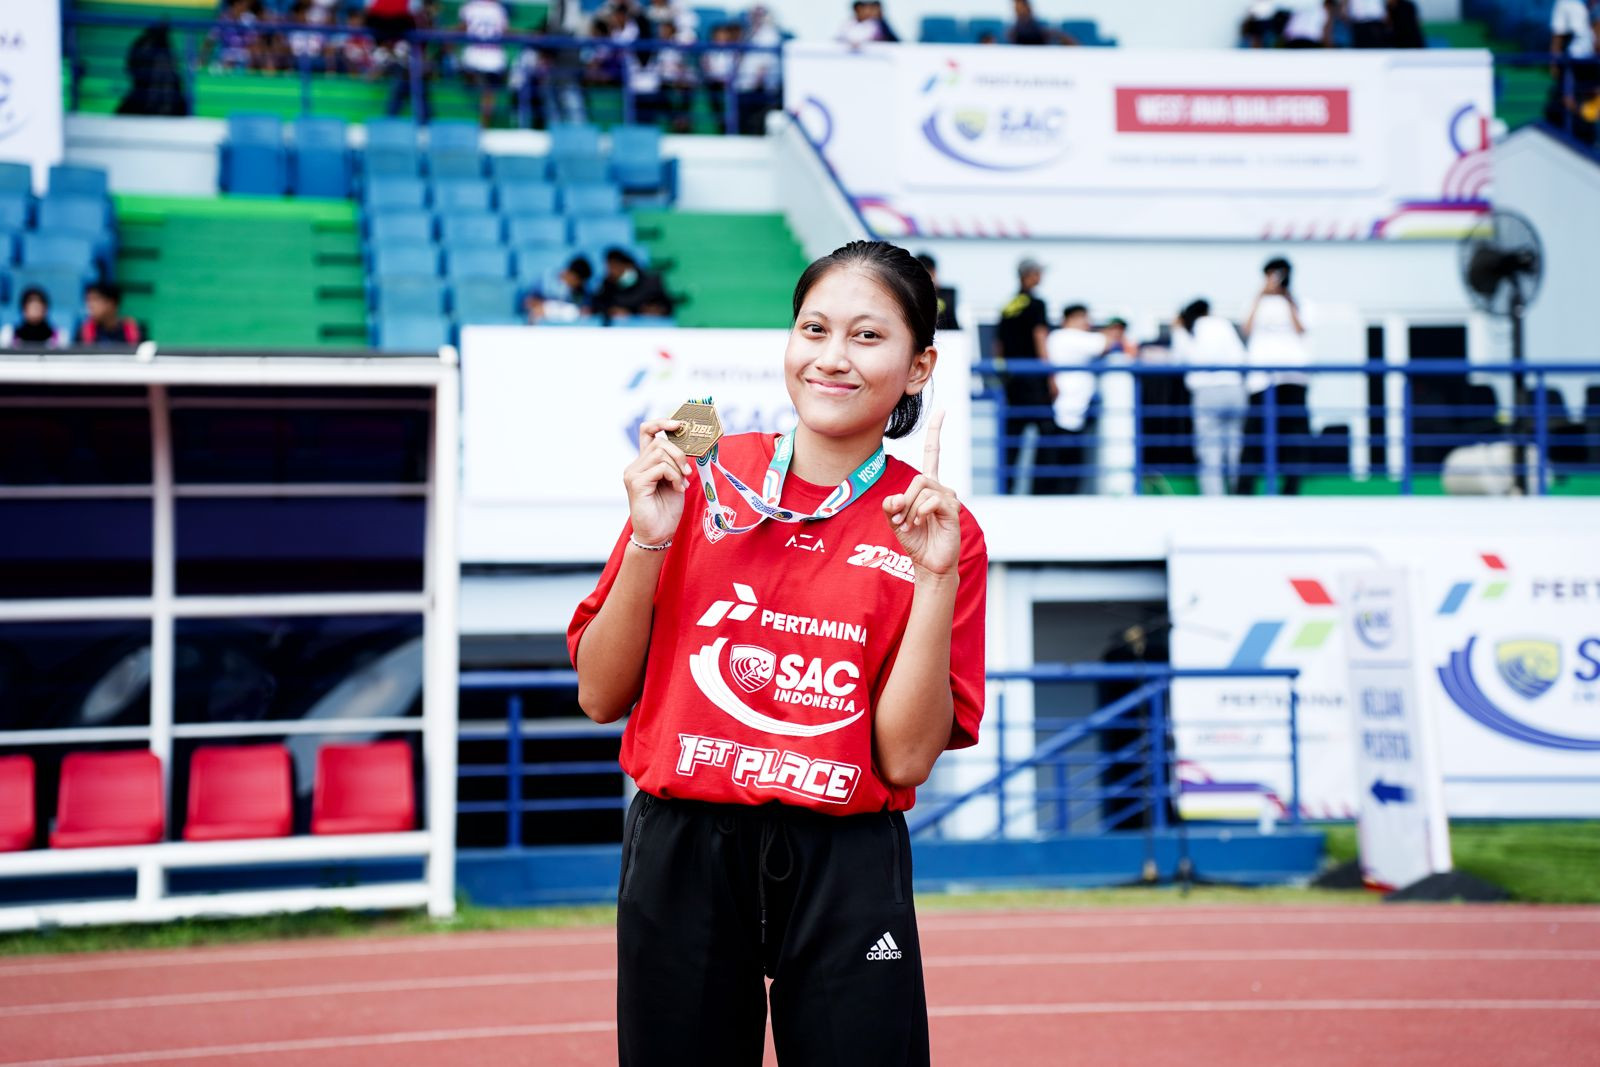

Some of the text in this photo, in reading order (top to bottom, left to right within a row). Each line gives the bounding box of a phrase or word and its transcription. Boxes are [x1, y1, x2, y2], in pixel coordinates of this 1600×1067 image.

[1133, 93, 1184, 126] WEST
[760, 609, 867, 646] PERTAMINA
[775, 654, 860, 697] SAC
[773, 689, 856, 713] INDONESIA
[677, 734, 860, 803] 1ST PLACE
[866, 949, 903, 961] adidas
